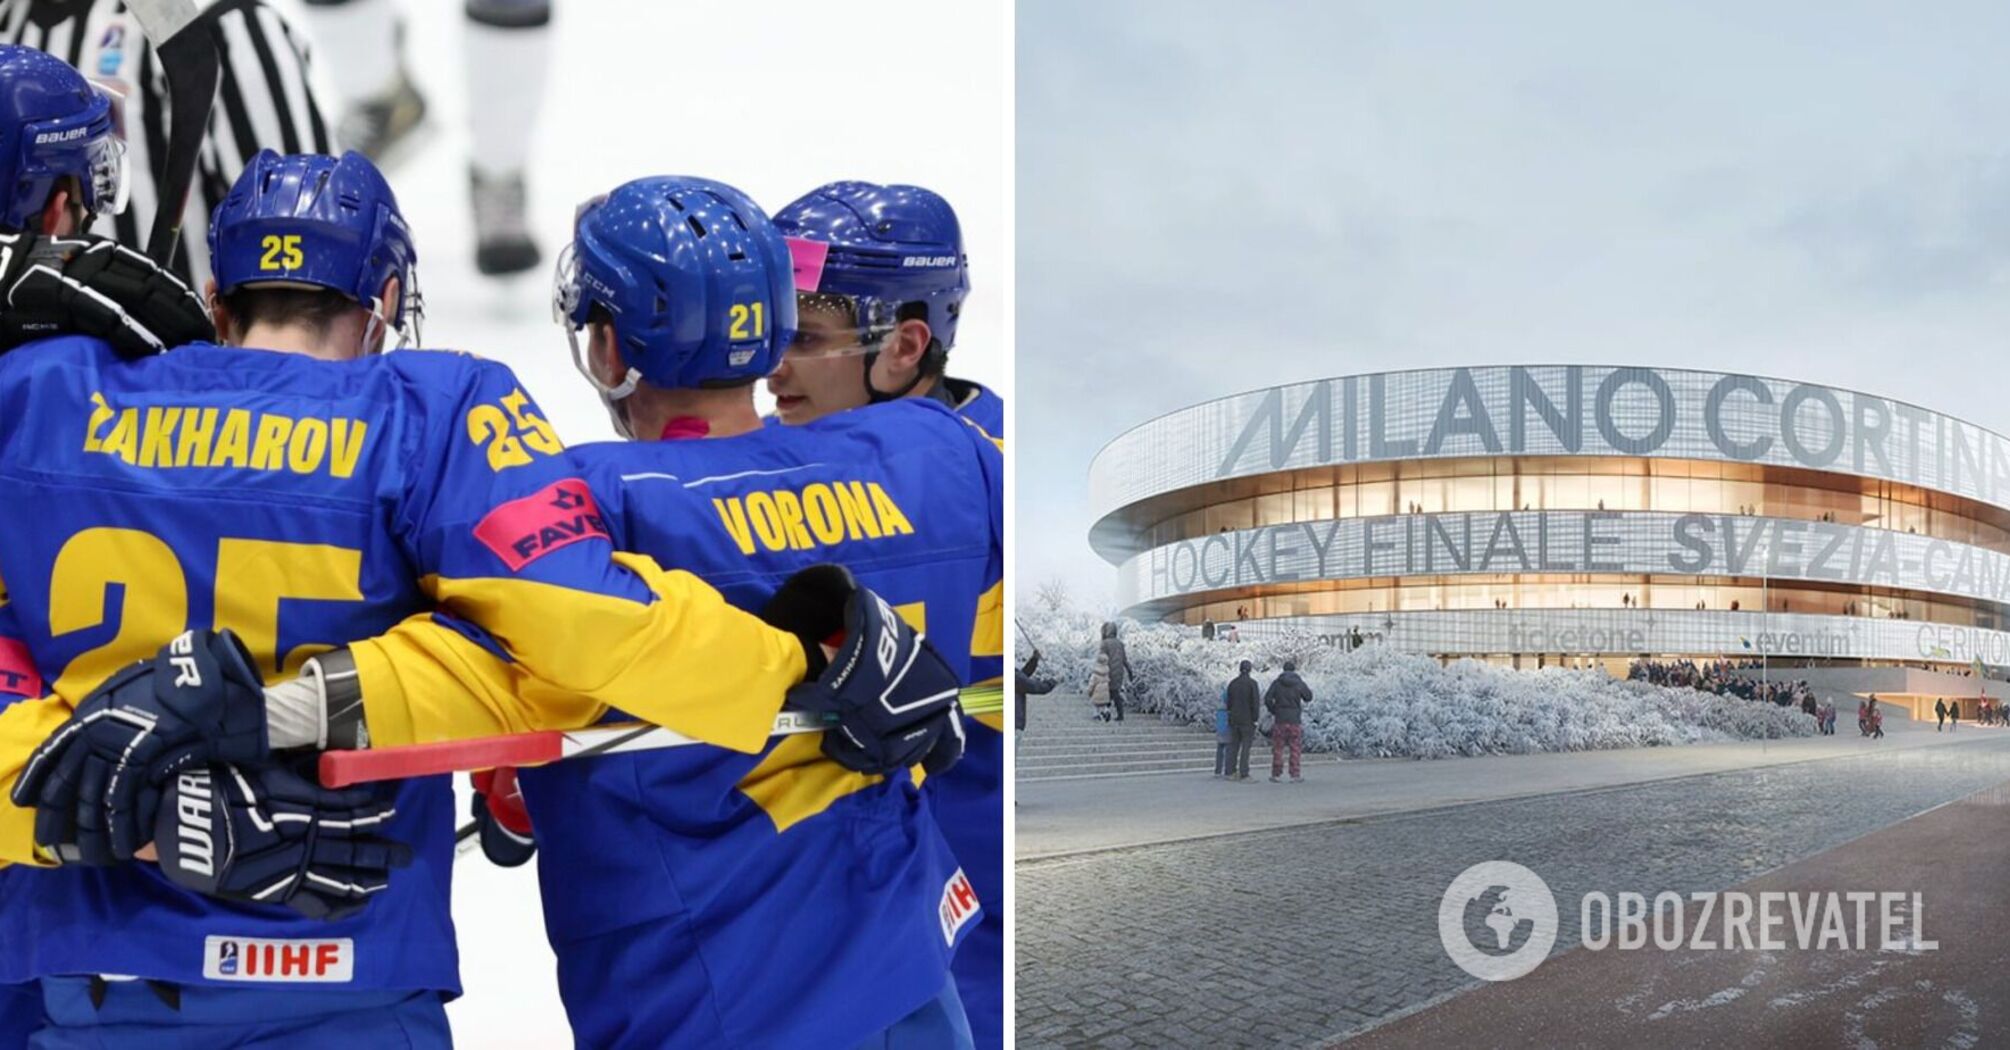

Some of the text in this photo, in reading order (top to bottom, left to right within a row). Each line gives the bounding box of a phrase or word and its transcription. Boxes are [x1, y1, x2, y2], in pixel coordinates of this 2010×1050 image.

[36, 127, 87, 144] BAUER
[260, 235, 304, 271] 25
[903, 256, 956, 268] BAUER
[729, 302, 763, 339] 21
[83, 391, 368, 479] ZAKHAROV
[466, 387, 565, 473] 25
[1215, 365, 1677, 478] MILANO
[712, 480, 914, 555] VORONA
[1150, 519, 1341, 597] HOCKEY
[1363, 512, 1624, 574] FINALE
[49, 526, 365, 700] 25
[1509, 622, 1645, 652] ticketone
[1756, 626, 1851, 654] eventim
[246, 944, 339, 976] IIHF
